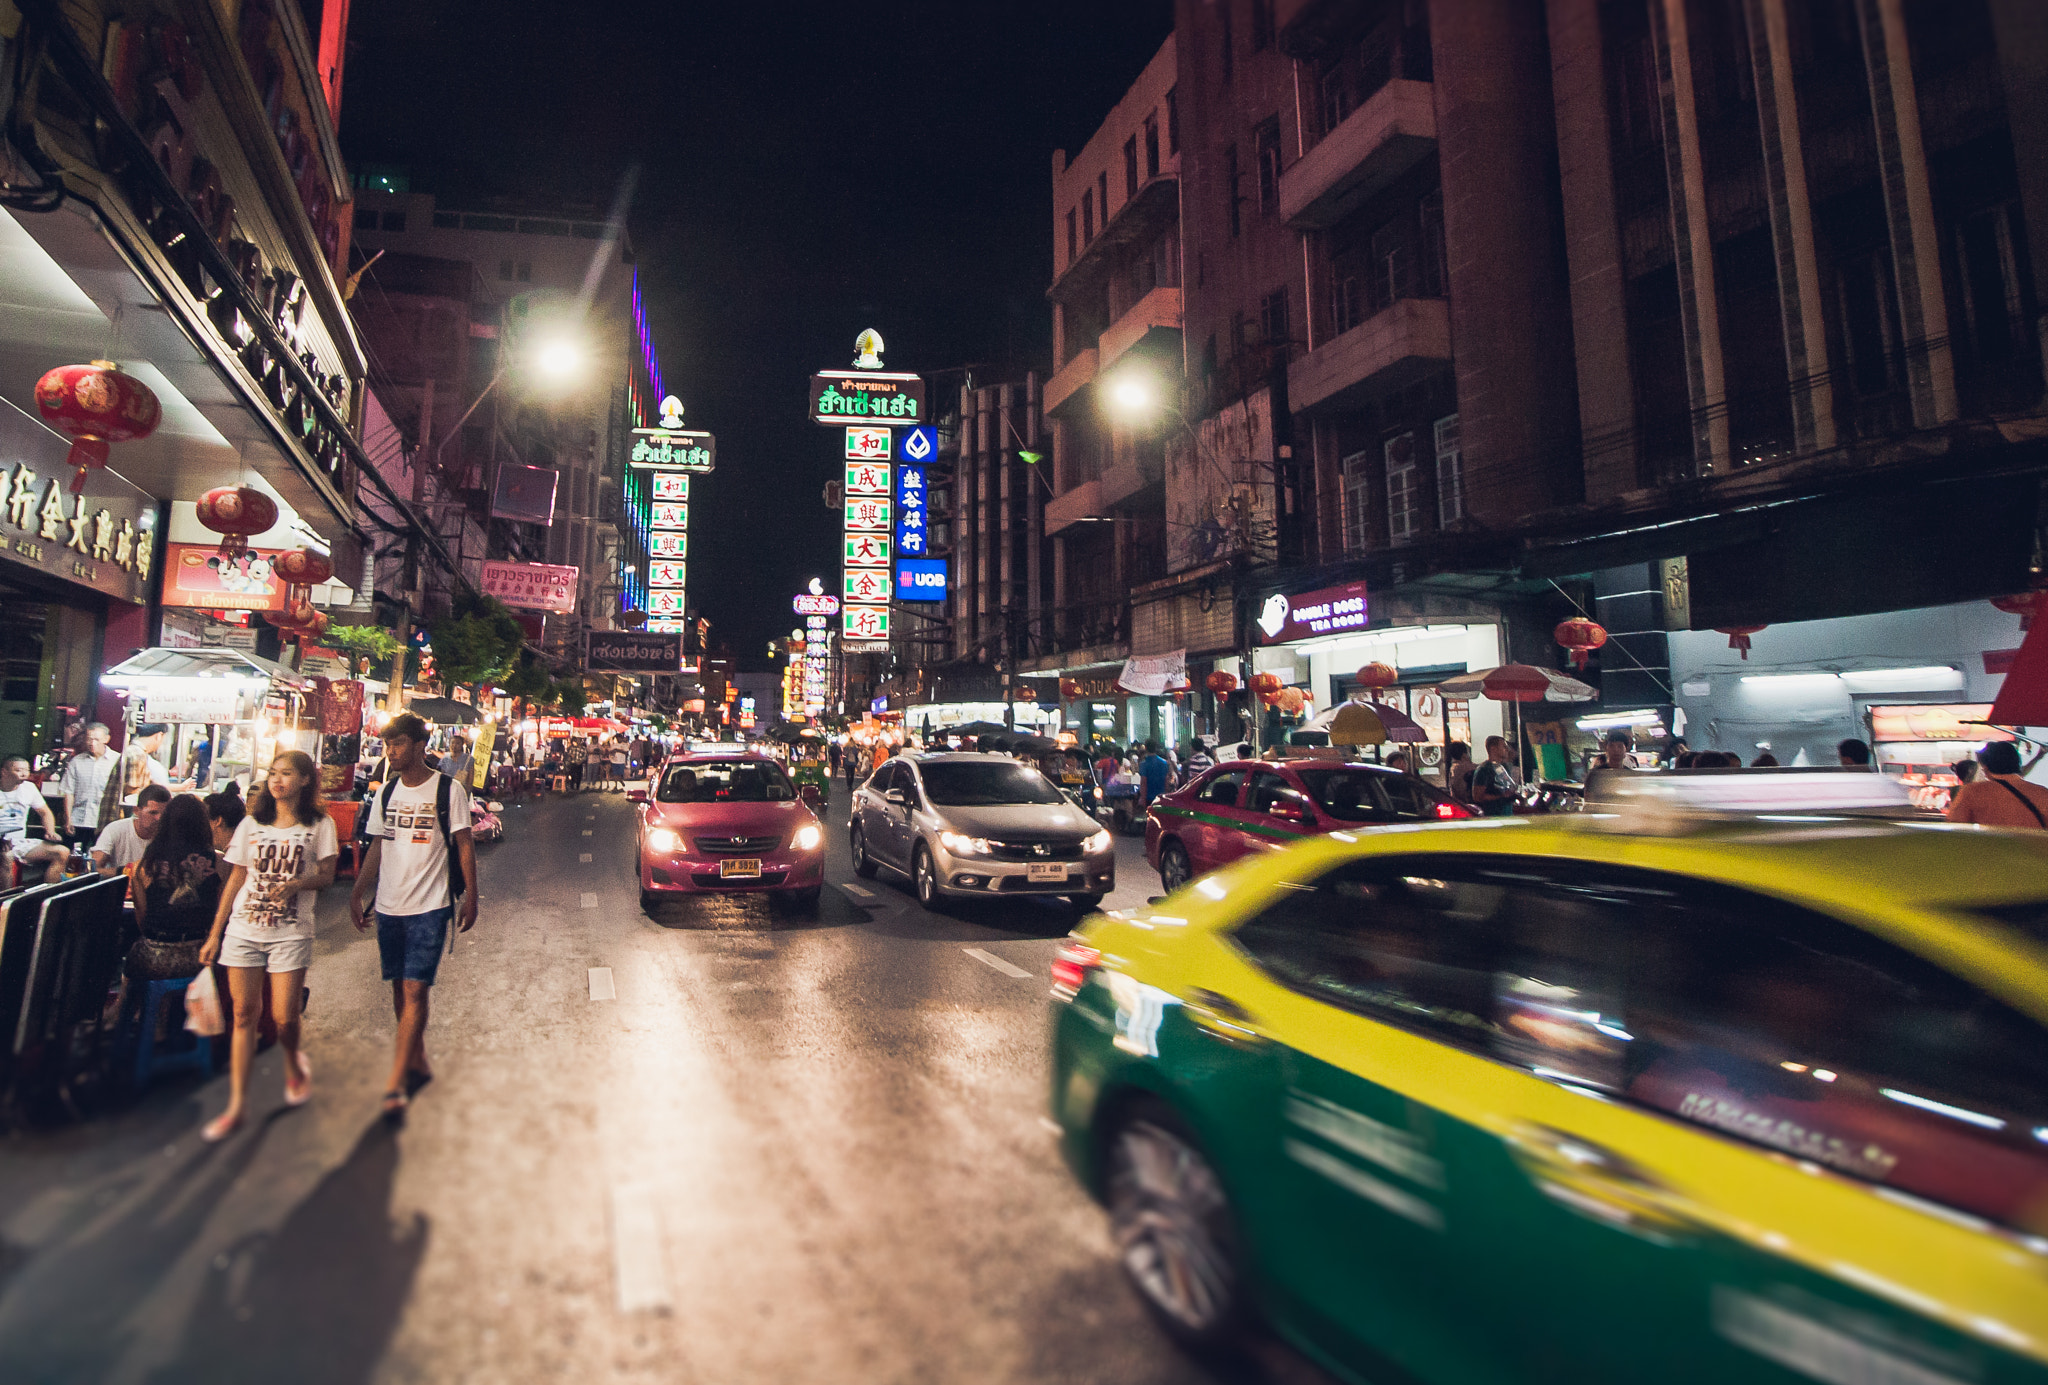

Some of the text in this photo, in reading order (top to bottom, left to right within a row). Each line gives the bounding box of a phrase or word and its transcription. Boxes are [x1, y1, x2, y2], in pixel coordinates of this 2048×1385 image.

[914, 572, 946, 588] UOB
[1293, 597, 1365, 622] DOUBLE DOGS
[1310, 613, 1365, 631] TEA ROOM
